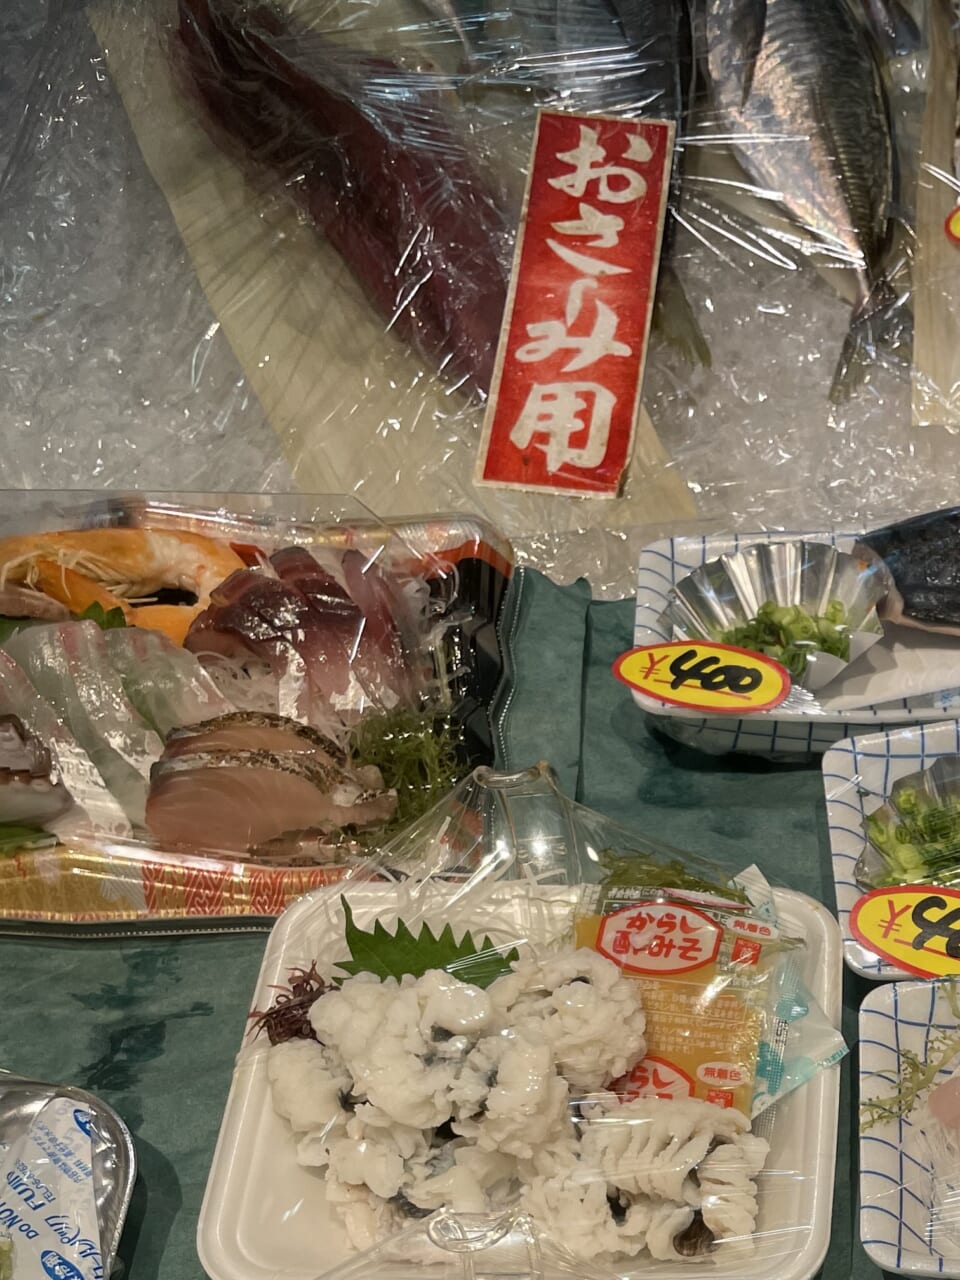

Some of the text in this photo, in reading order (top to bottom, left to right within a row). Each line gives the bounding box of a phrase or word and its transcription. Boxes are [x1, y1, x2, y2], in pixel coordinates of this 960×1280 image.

[509, 124, 654, 475] おさしみ用
[639, 649, 763, 694] ¥400
[626, 911, 702, 934] からし
[19, 1223, 40, 1240] DO
